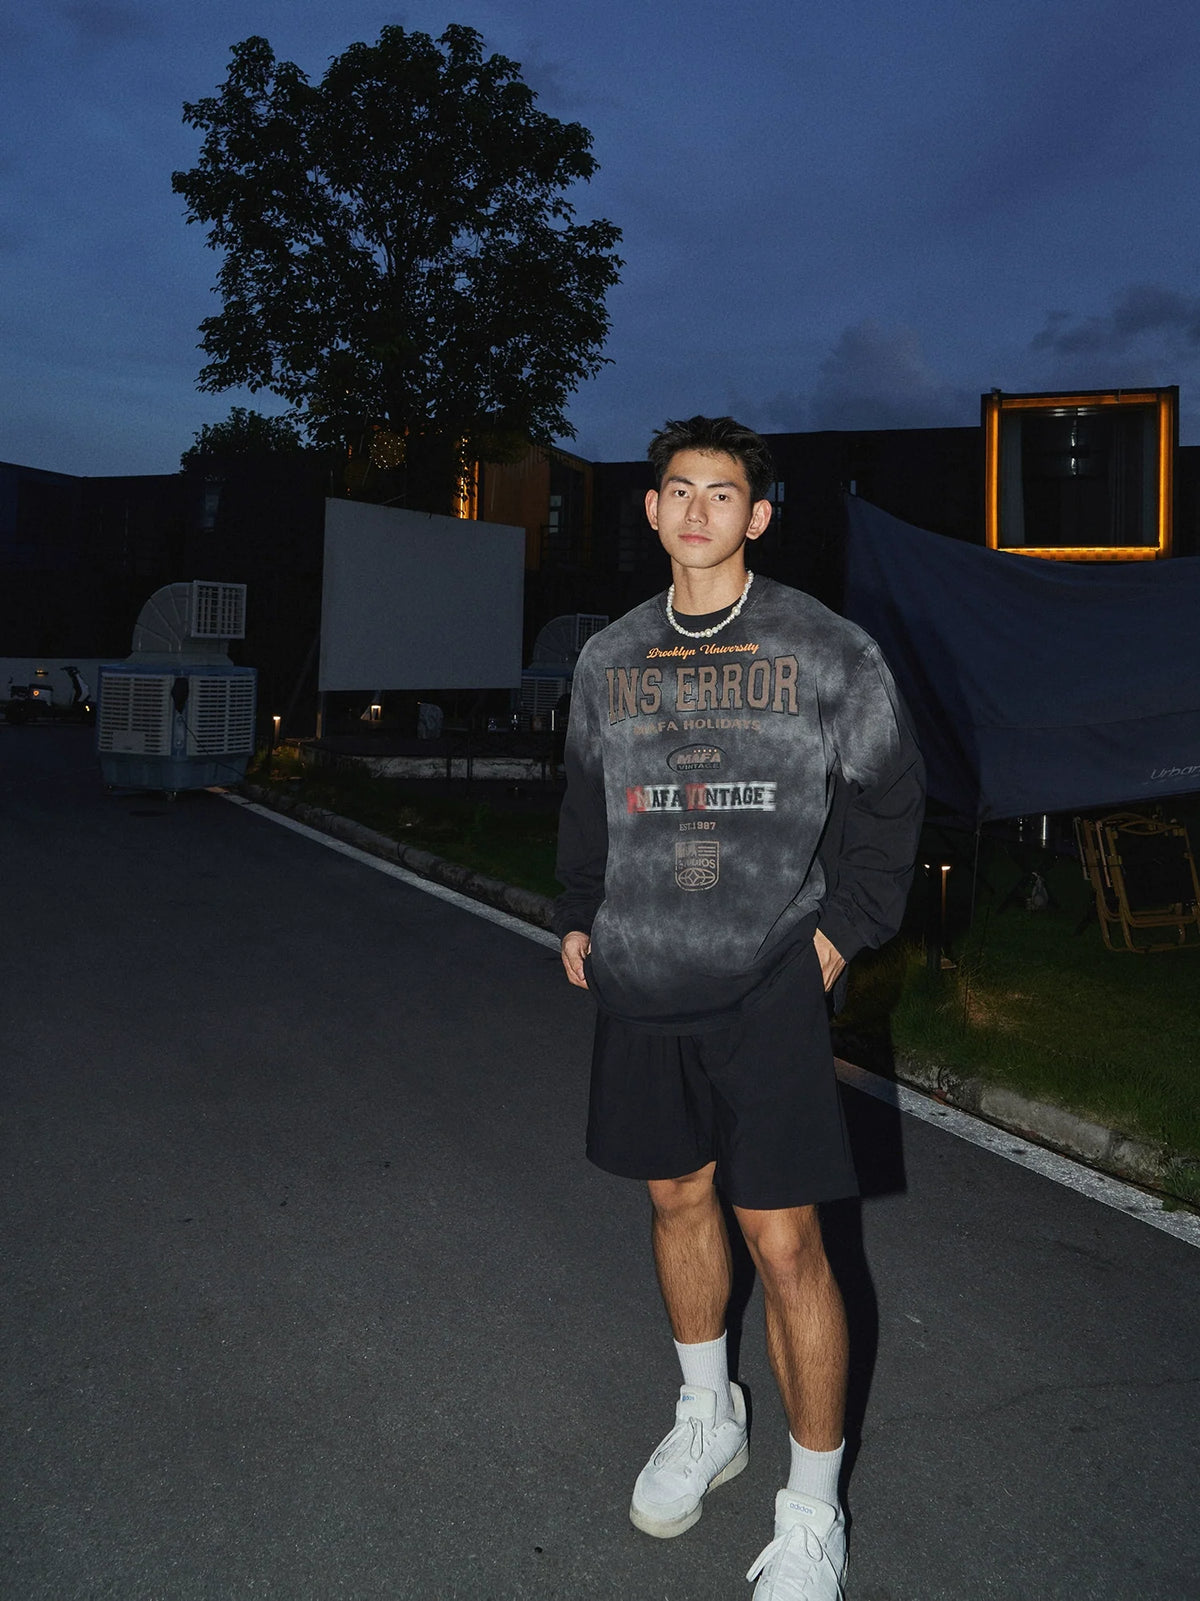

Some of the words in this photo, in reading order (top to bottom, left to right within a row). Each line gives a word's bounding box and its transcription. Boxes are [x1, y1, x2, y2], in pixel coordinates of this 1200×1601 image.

[646, 646, 696, 660] Brooklyn
[699, 642, 759, 655] University
[605, 667, 664, 726] INS
[675, 654, 800, 717] ERROR
[683, 719, 762, 733] HOLIDAYS
[677, 753, 721, 764] MAFA
[687, 787, 765, 809] VINTAGE
[789, 1502, 814, 1515] adidas
